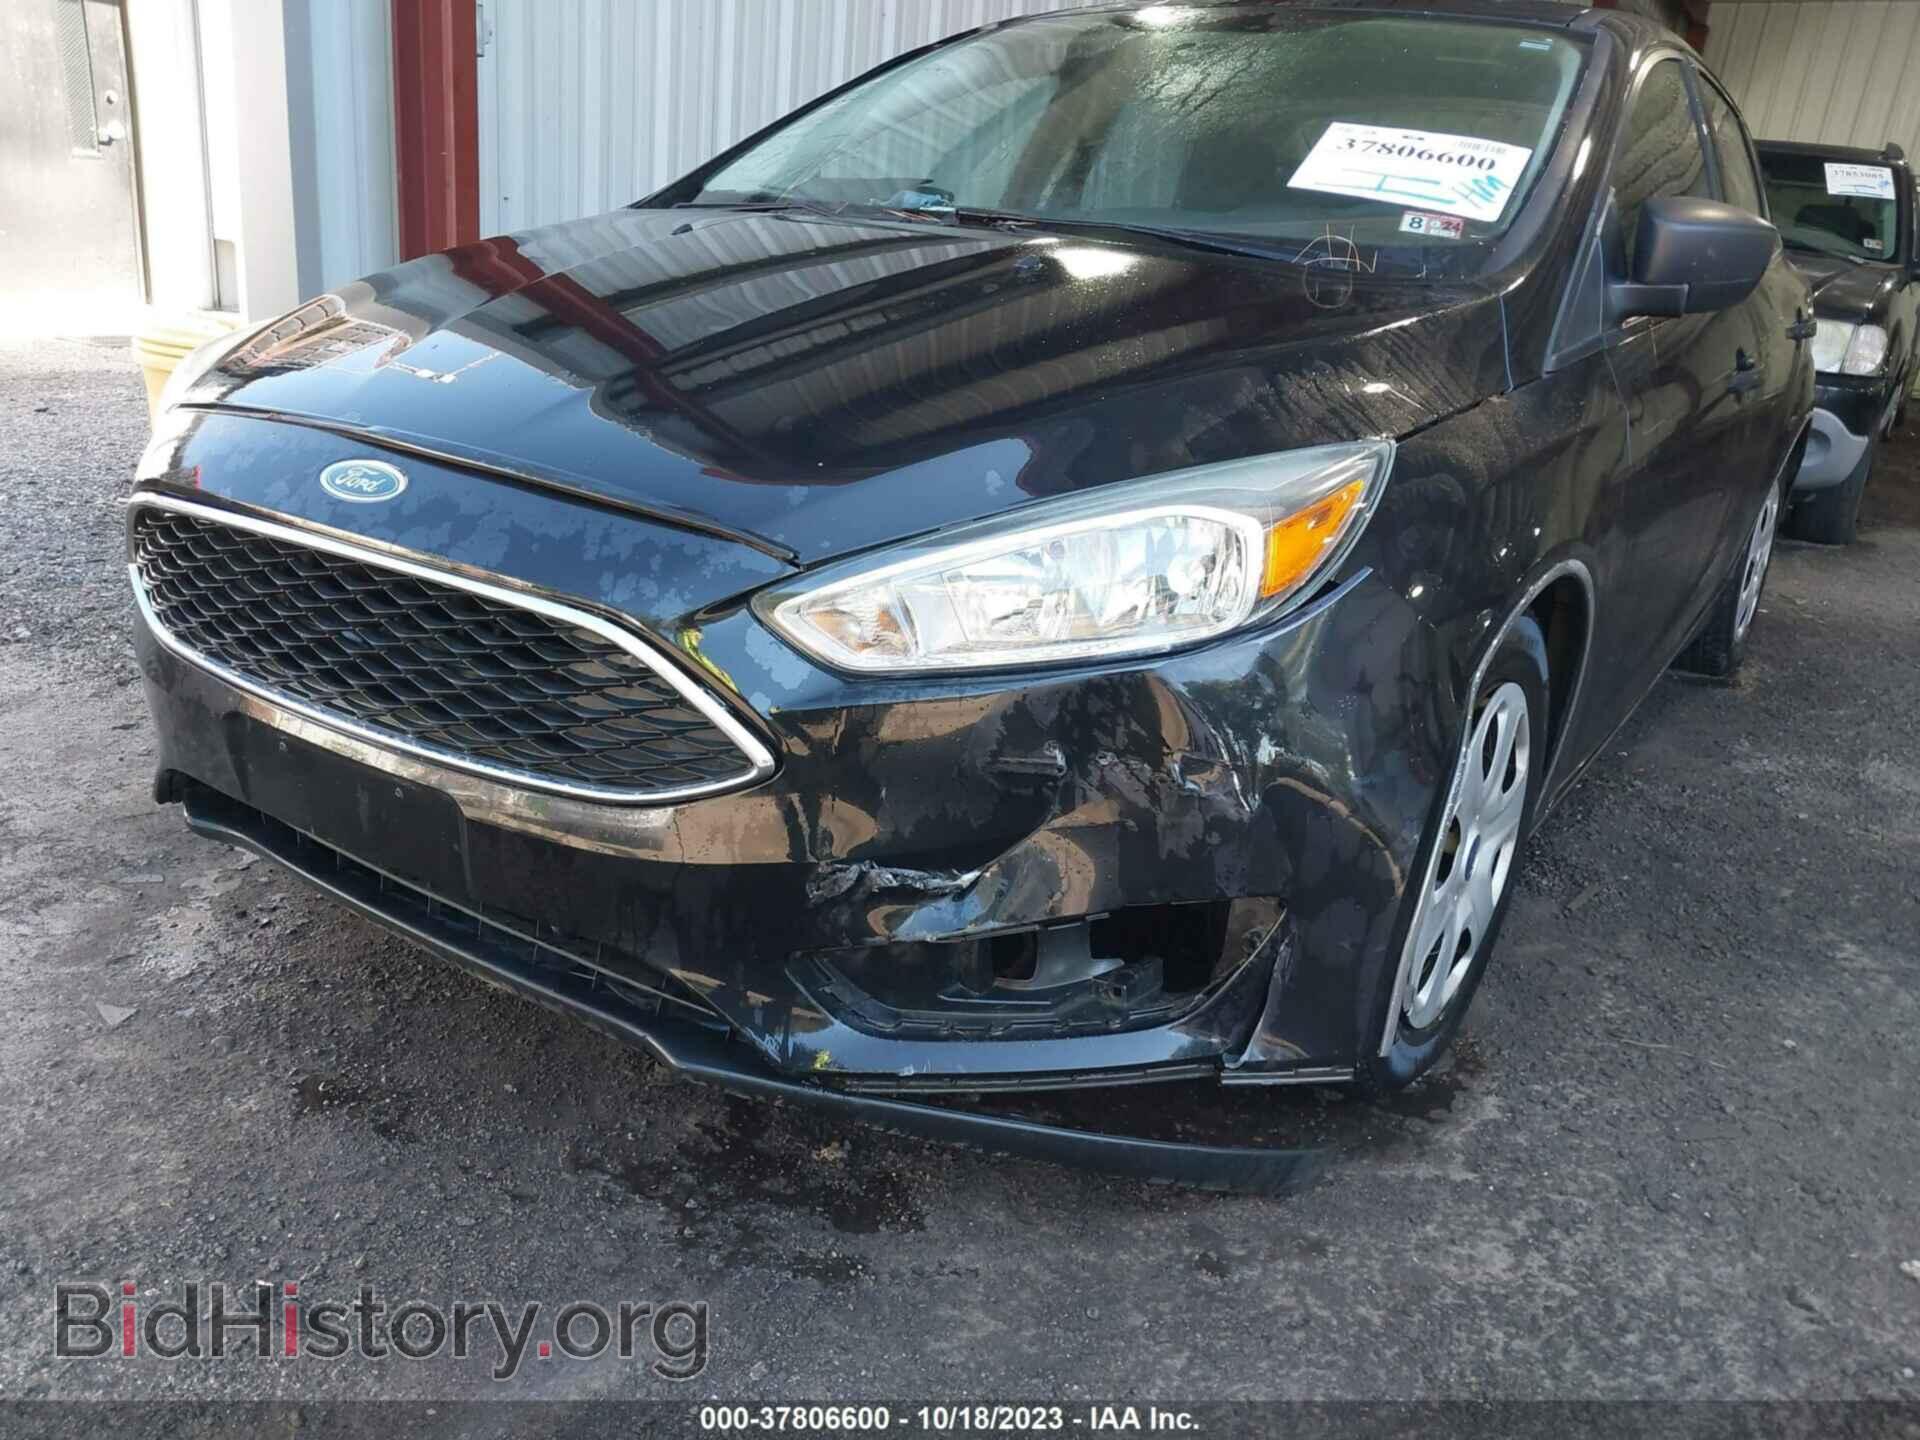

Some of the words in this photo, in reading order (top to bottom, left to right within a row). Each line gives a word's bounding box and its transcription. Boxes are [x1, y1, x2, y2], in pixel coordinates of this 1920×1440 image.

[1336, 137, 1497, 172] 37806600
[1408, 216, 1424, 230] 8
[334, 465, 388, 492] Ford
